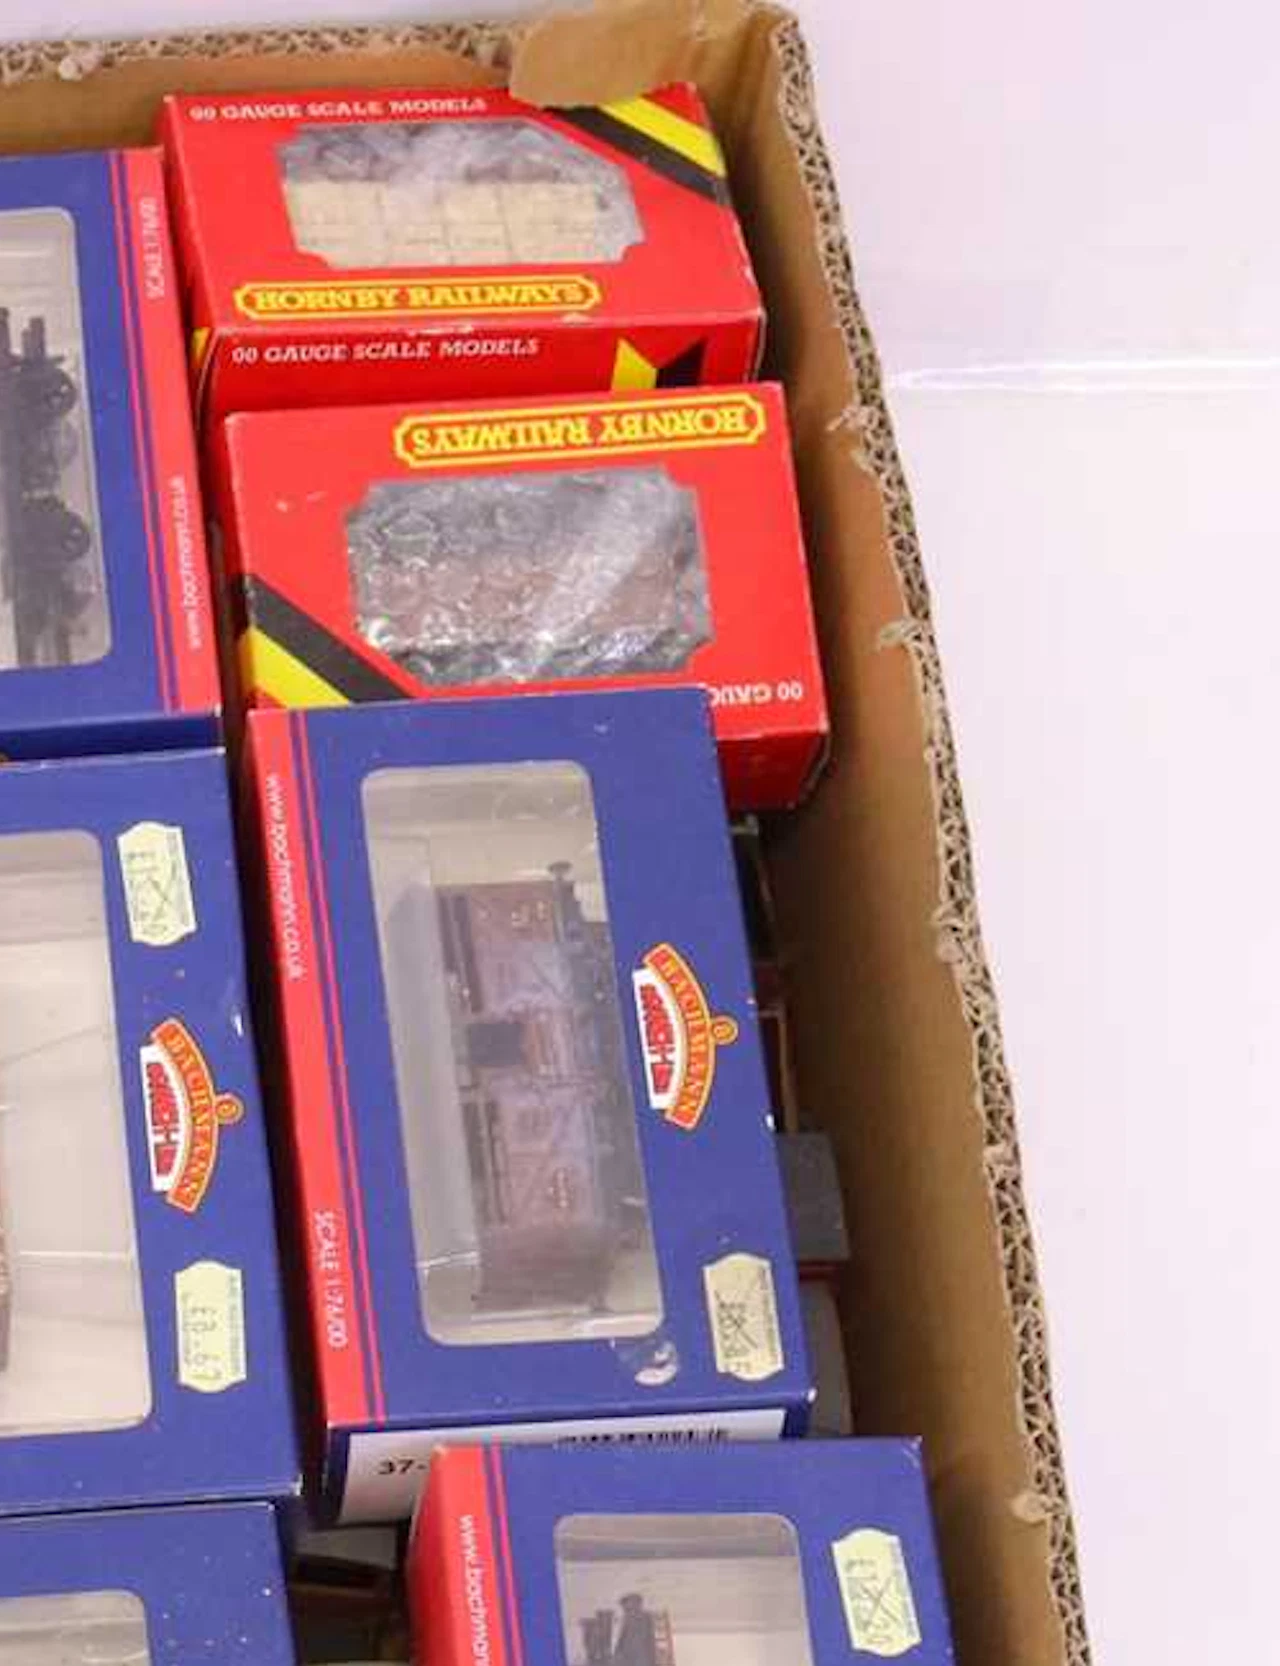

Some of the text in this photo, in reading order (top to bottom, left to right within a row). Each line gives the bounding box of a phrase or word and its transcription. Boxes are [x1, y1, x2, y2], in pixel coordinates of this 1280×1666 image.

[222, 100, 303, 119] GAUGE
[305, 98, 385, 117] SCALE
[388, 96, 487, 115] MODELS
[253, 282, 585, 312] HORNBY RAILWAYS
[263, 342, 349, 362] GAUGE
[352, 341, 431, 361] SCALE
[440, 338, 538, 358] MODELS
[412, 404, 747, 454] HORNBY RAILWAYS
[708, 686, 773, 708] GAUG
